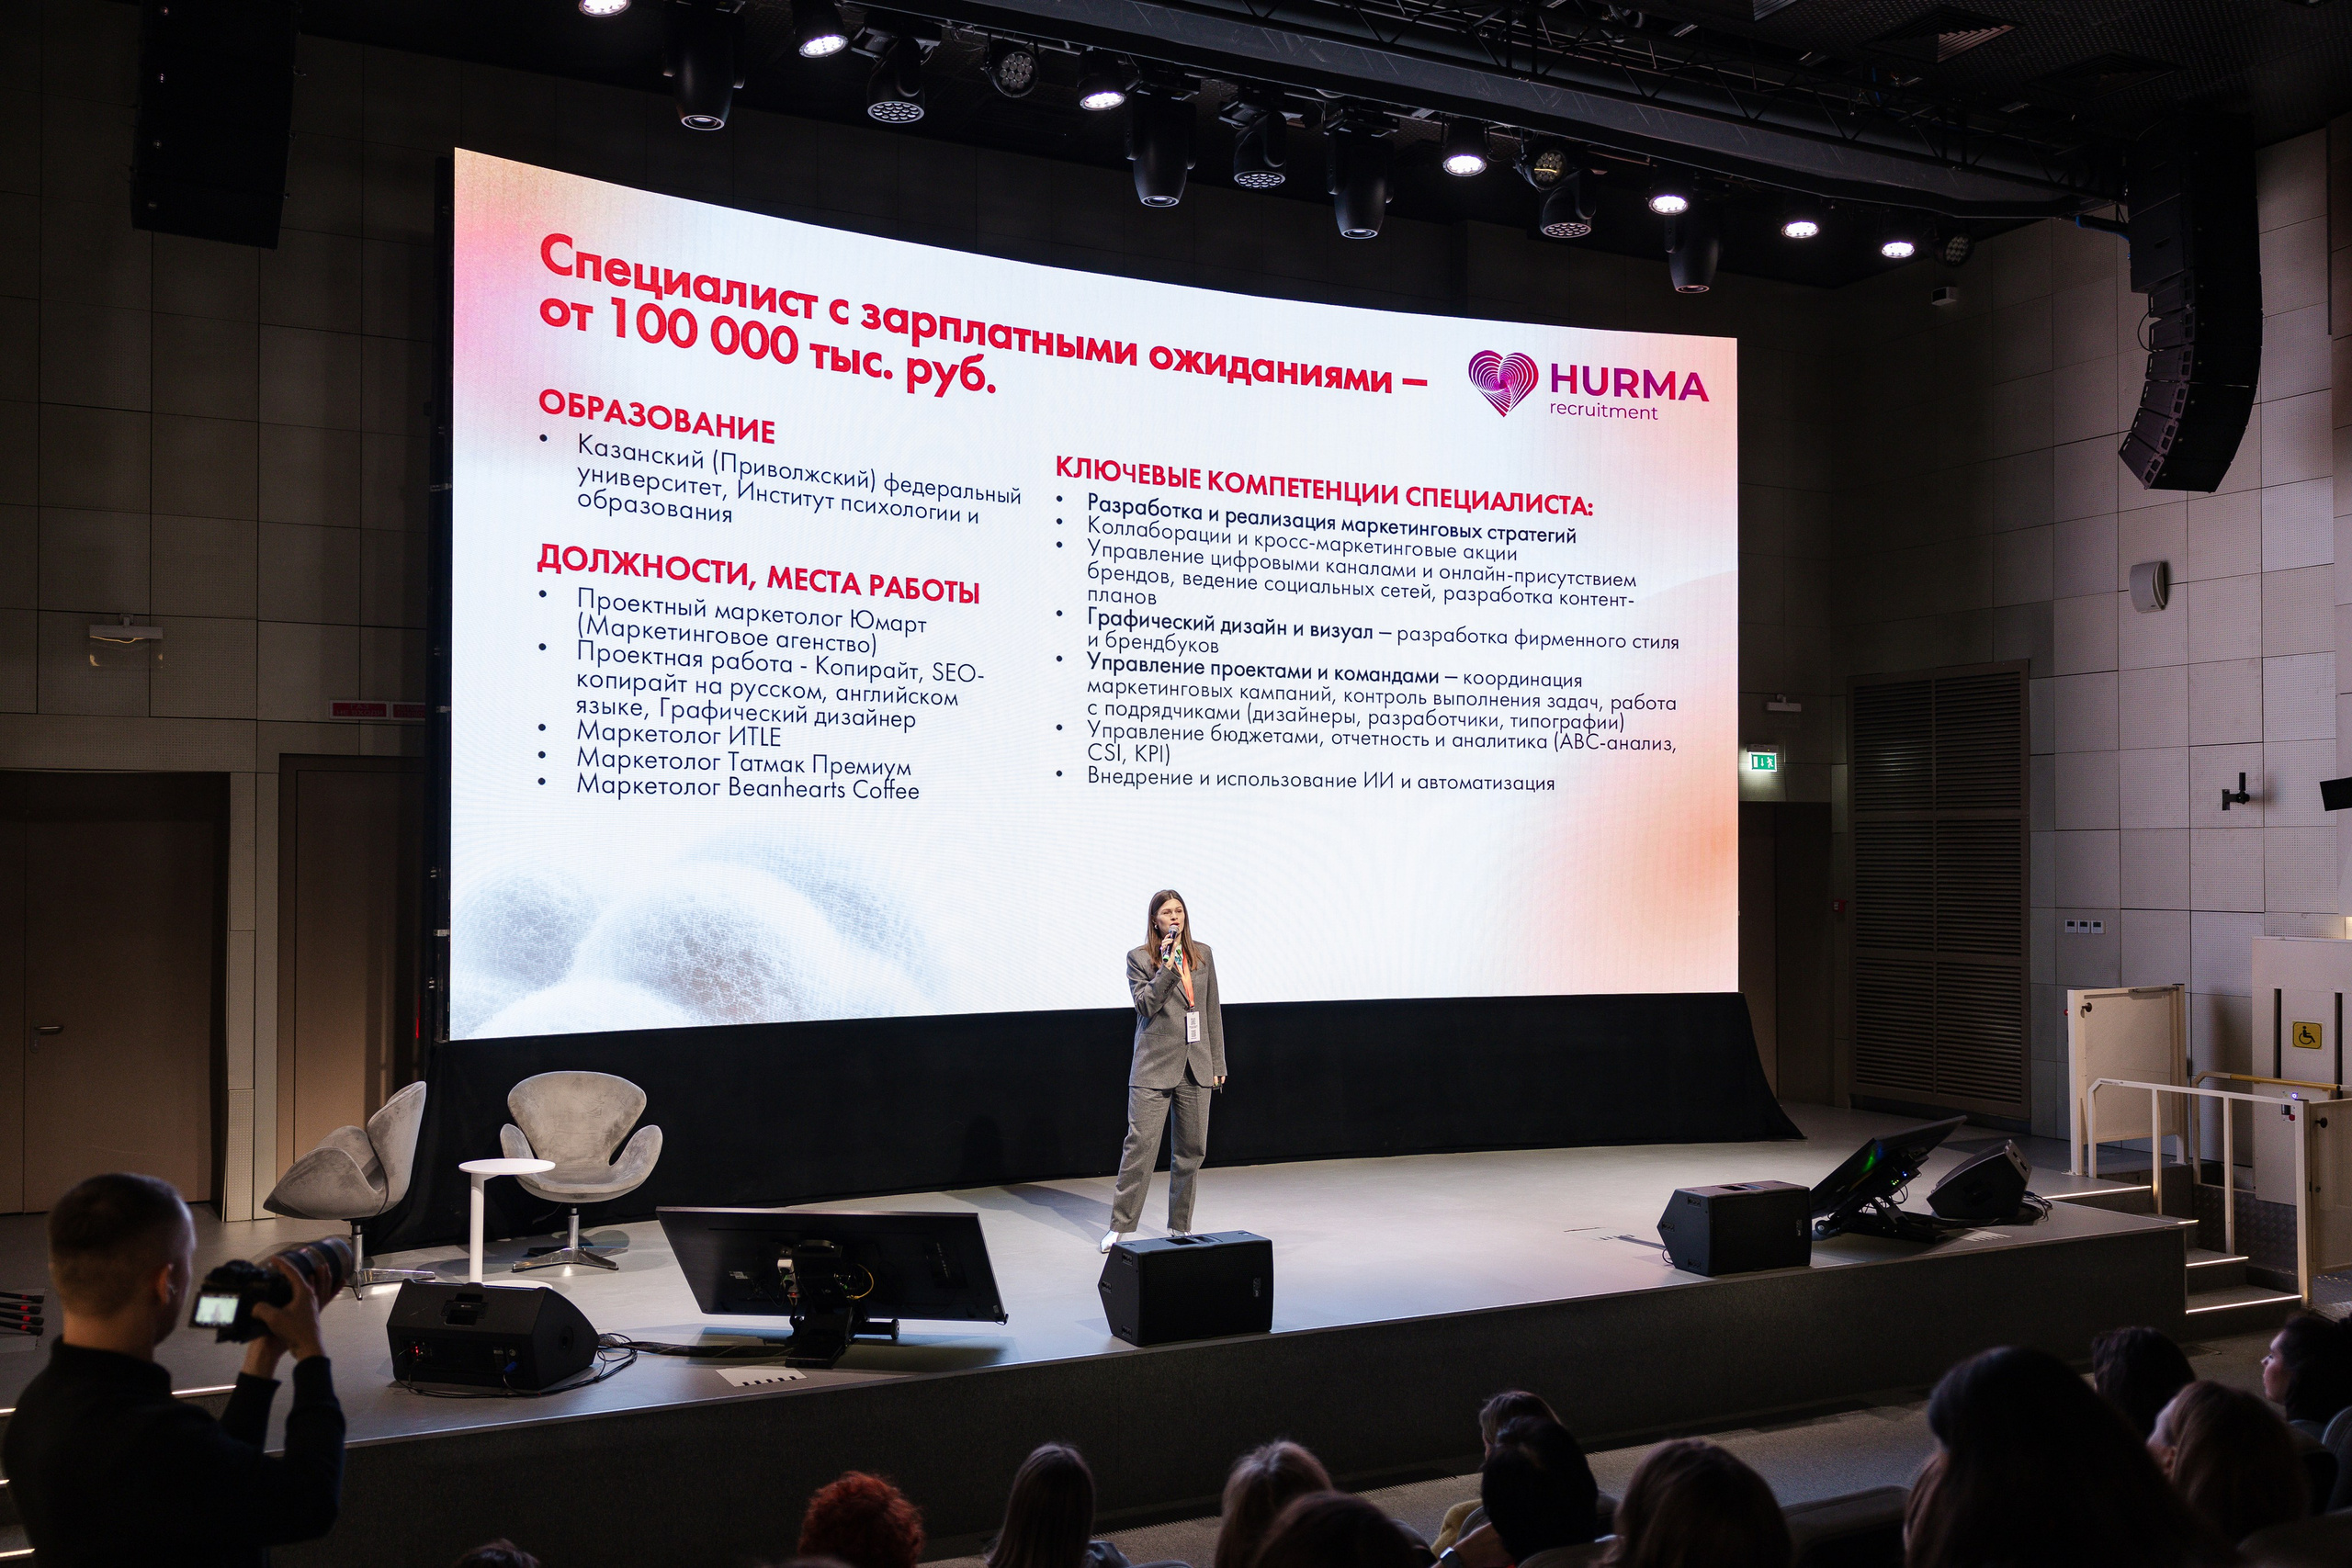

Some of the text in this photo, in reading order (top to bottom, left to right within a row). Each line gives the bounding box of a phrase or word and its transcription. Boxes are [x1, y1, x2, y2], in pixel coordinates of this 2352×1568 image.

[539, 232, 820, 320] Специалист
[828, 298, 850, 326] с
[860, 302, 1137, 367] зарплатными
[1148, 344, 1393, 394] ожиданиями
[539, 296, 997, 399] от 100 000 тыс. руб.
[1551, 362, 1710, 402] HURMA
[538, 388, 775, 445] ОБРАЗОВАНИЕ
[1550, 401, 1659, 421] recruitment
[578, 432, 1021, 505] Казанский (Приволжский) федеральный
[1056, 455, 1594, 517] КЛЮЧЕВЫЕ КОМПЕТЕНЦИИ СПЕЦИАЛИСТА:
[576, 466, 978, 525] университет, Институт психологии и
[577, 487, 732, 524] образования
[1088, 491, 1577, 546] Разработка и реализация маркетинговых стратегий
[1088, 514, 1517, 563] Коллаборации и кросс-маркетинговые акции
[537, 543, 980, 604] ДОЛЖНОСТИ, МЕСТА РАБОТЫ
[1087, 537, 1637, 590] Управление цифровыми каналами и онлайн-присутствием
[1087, 559, 1634, 607] брендов, ведение социальных сетей, разработка контент-
[578, 586, 928, 638] Проектный маркетолог Юмарт
[1088, 589, 1158, 605] планов
[578, 611, 876, 659] (Маркетинговое агенство)
[1088, 605, 1215, 633] Графический
[1219, 618, 1287, 636] дизайн
[1293, 624, 1304, 637] и
[1310, 625, 1374, 644] визуал
[1397, 625, 1508, 648] разработка
[1514, 627, 1627, 651] фирменного
[1632, 637, 1679, 650] стиля
[1088, 628, 1219, 658] и брендбуков
[578, 638, 703, 669] Проектная
[711, 649, 793, 675] работа
[816, 654, 923, 684] Копирайт,
[932, 661, 985, 683] SEO-
[1086, 650, 1205, 677] Управление
[1210, 663, 1312, 682] проектами
[1317, 667, 1329, 681] и
[1334, 668, 1440, 686] командами
[1464, 673, 1582, 691] координация
[577, 672, 959, 706] копирайт на русском, английском
[1087, 681, 1677, 715] маркетинговых кампаний, контроль выполнения задач, работа
[576, 696, 916, 734] языке, Графический дизайнер
[577, 718, 721, 749] Маркетолог
[1087, 701, 1624, 732] с подрядчиками (дизайнеры, разработчики, типографии)
[1087, 719, 1204, 745] Управление
[1210, 723, 1324, 748] бюджетами,
[1331, 733, 1430, 750] отчетность
[1434, 735, 1446, 751] и
[1452, 736, 1547, 750] аналитика
[577, 745, 912, 782] Маркетолог Татмак Премиум
[1087, 742, 1170, 767] CSI, KPI)
[576, 772, 920, 801] Маркетолог Beanhearts Coffee
[1088, 765, 1555, 794] Внедрение и использование ИИ и автоматизация
